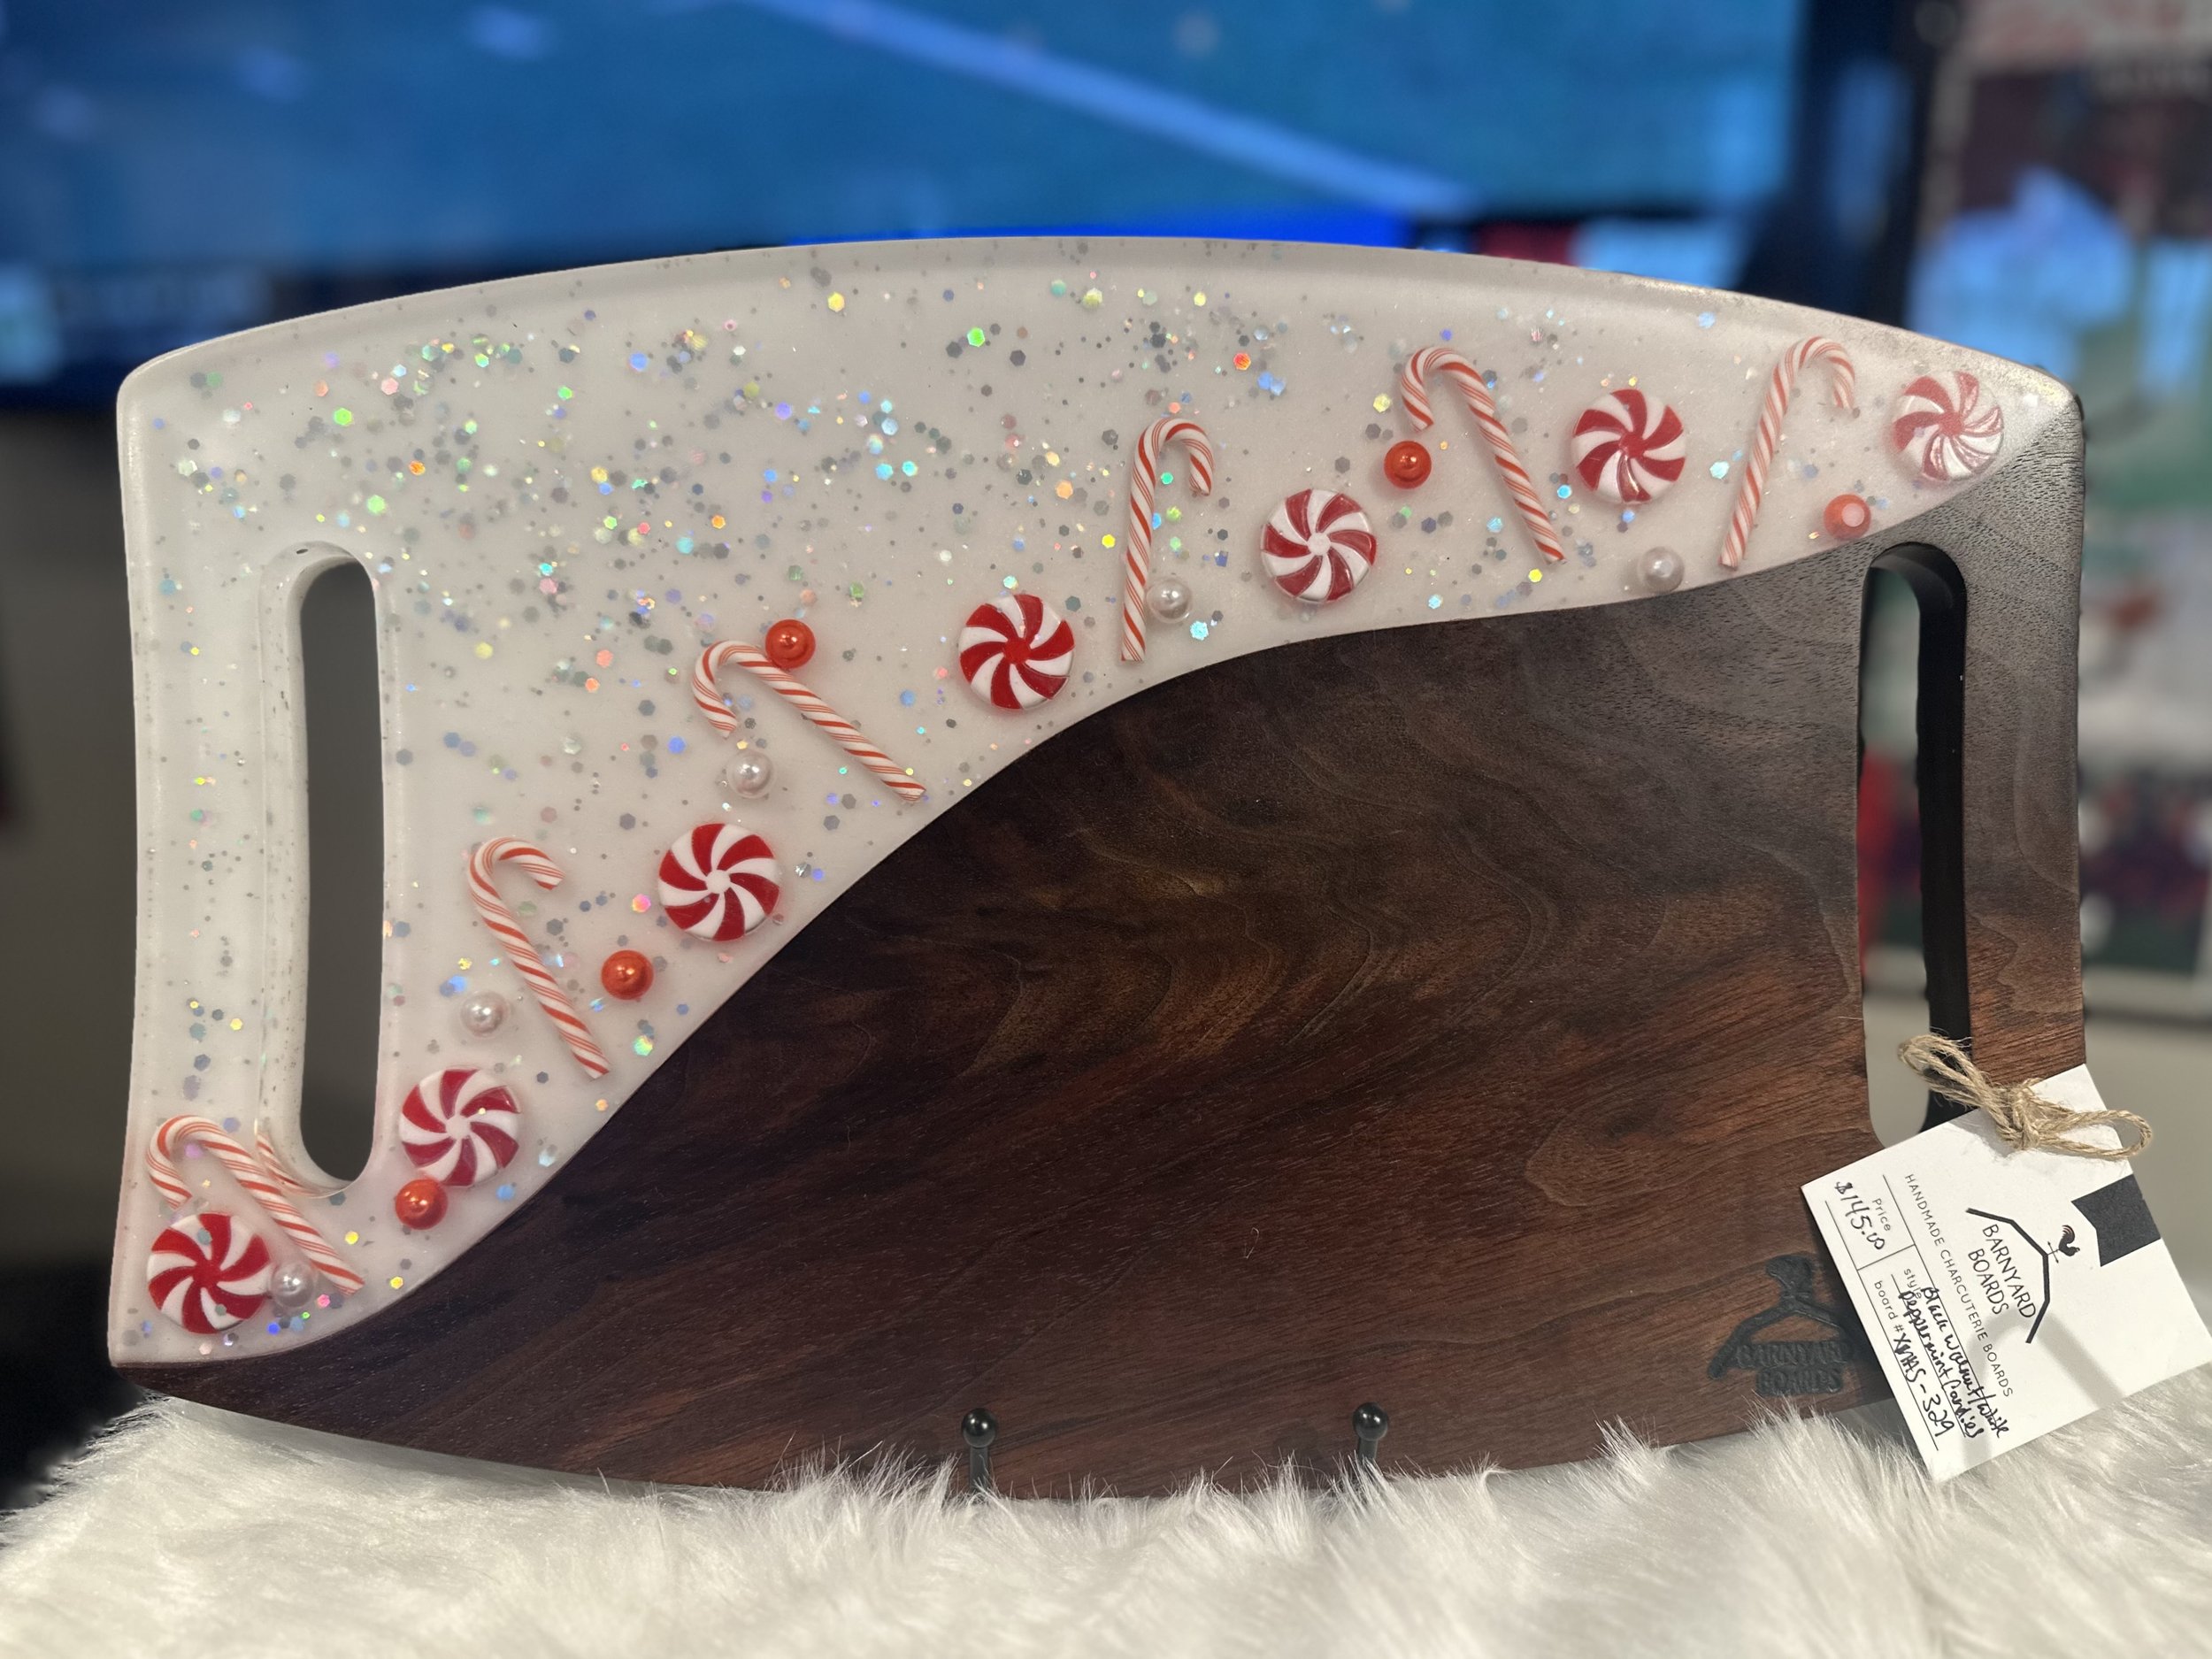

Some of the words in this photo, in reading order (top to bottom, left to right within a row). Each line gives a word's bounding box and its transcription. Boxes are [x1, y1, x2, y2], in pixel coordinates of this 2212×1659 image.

[1871, 1197, 1892, 1232] Price
[1903, 1268, 1923, 1300] style
[1904, 1173, 1946, 1247] HANDMADE
[1939, 1249, 1988, 1341] CHARCUTERIE
[1982, 1343, 2014, 1398] BOARDS
[1968, 1248, 2009, 1315] BOARDS
[1982, 1224, 2037, 1318] BARNYARD
[1873, 1279, 1899, 1321] board
[1921, 1286, 1947, 1333] Black
